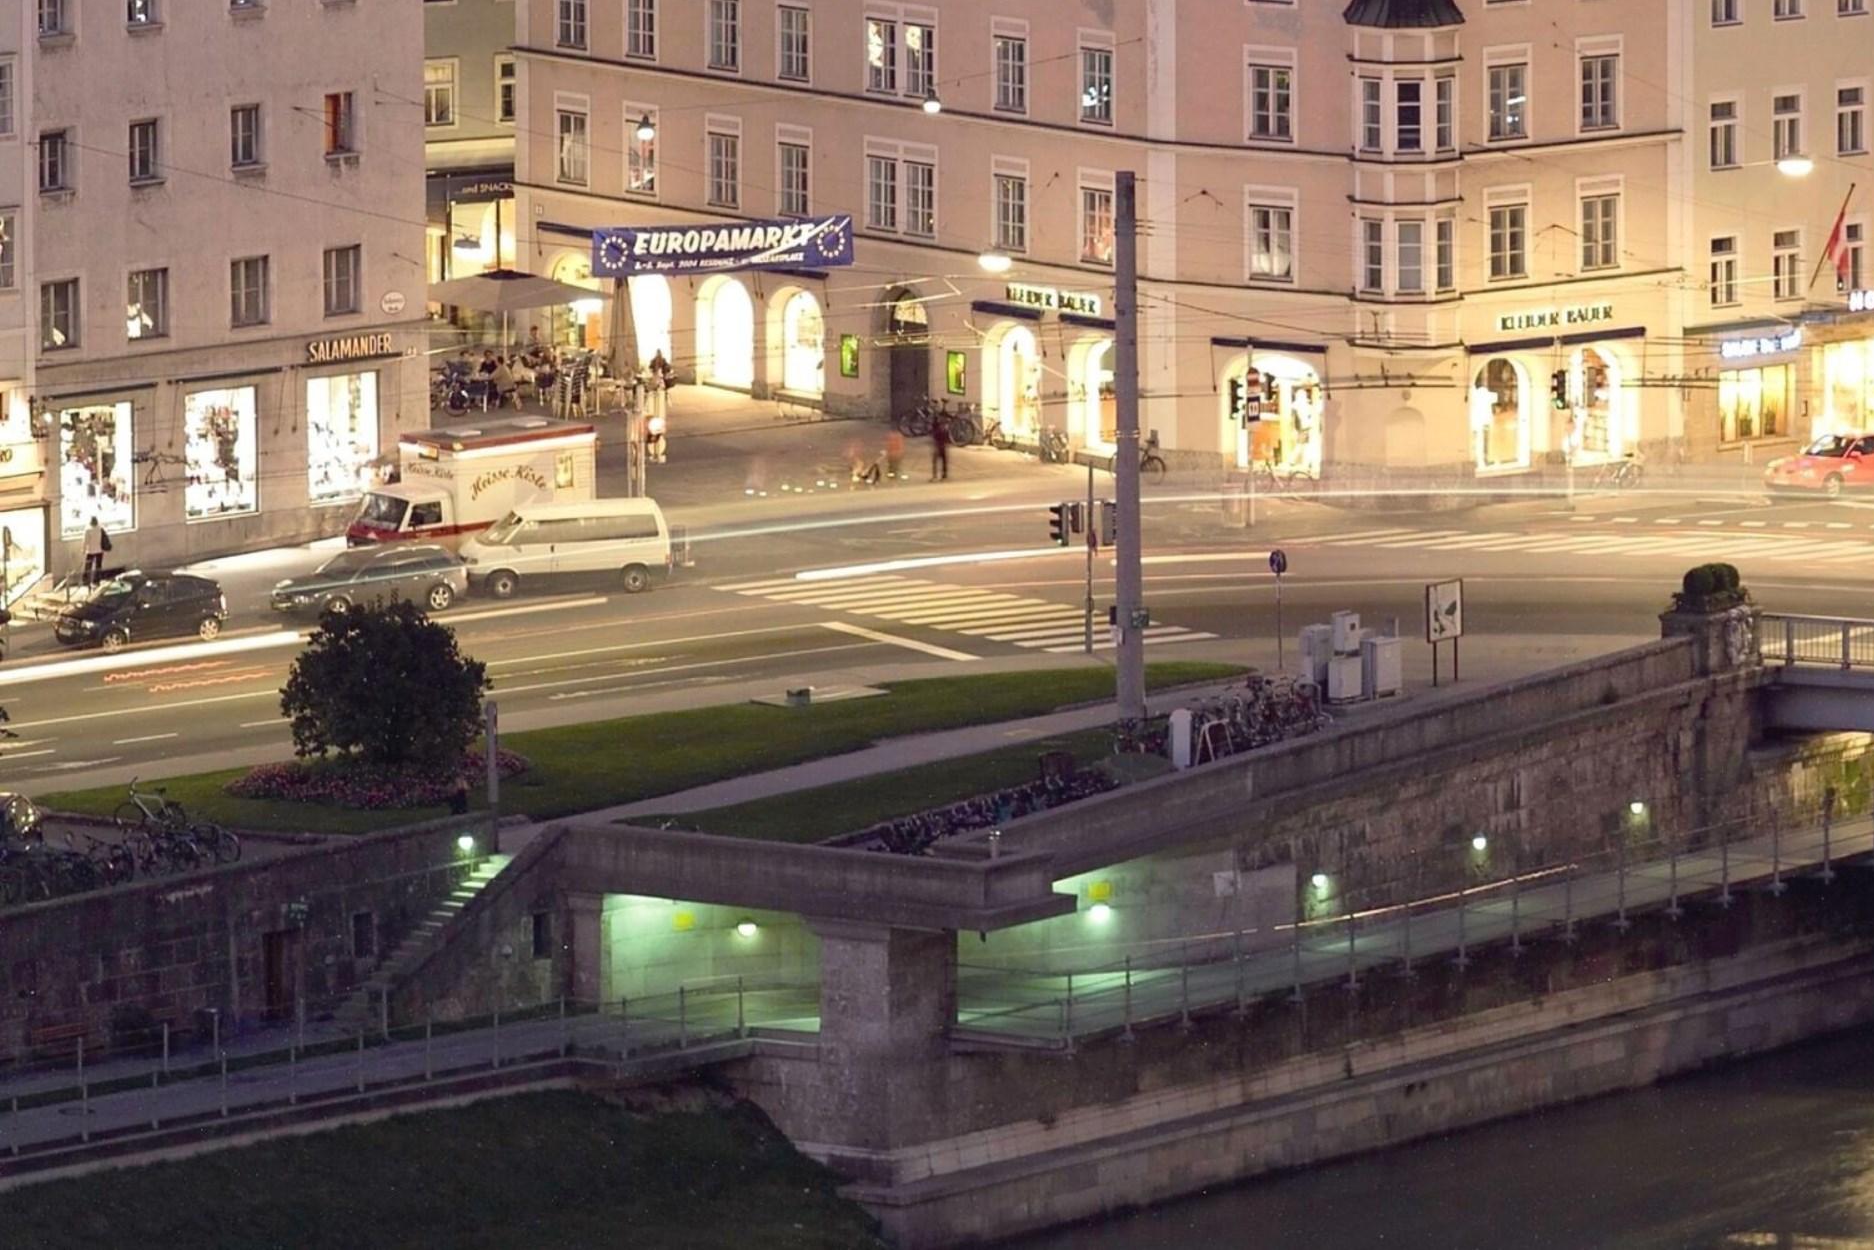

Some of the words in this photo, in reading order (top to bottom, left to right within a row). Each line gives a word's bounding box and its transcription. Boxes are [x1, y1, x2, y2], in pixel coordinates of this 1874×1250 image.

[634, 223, 814, 255] EUROPAMARKT
[309, 333, 392, 362] SALAMANDER
[471, 468, 510, 501] Heisse
[513, 465, 547, 490] Kiste
